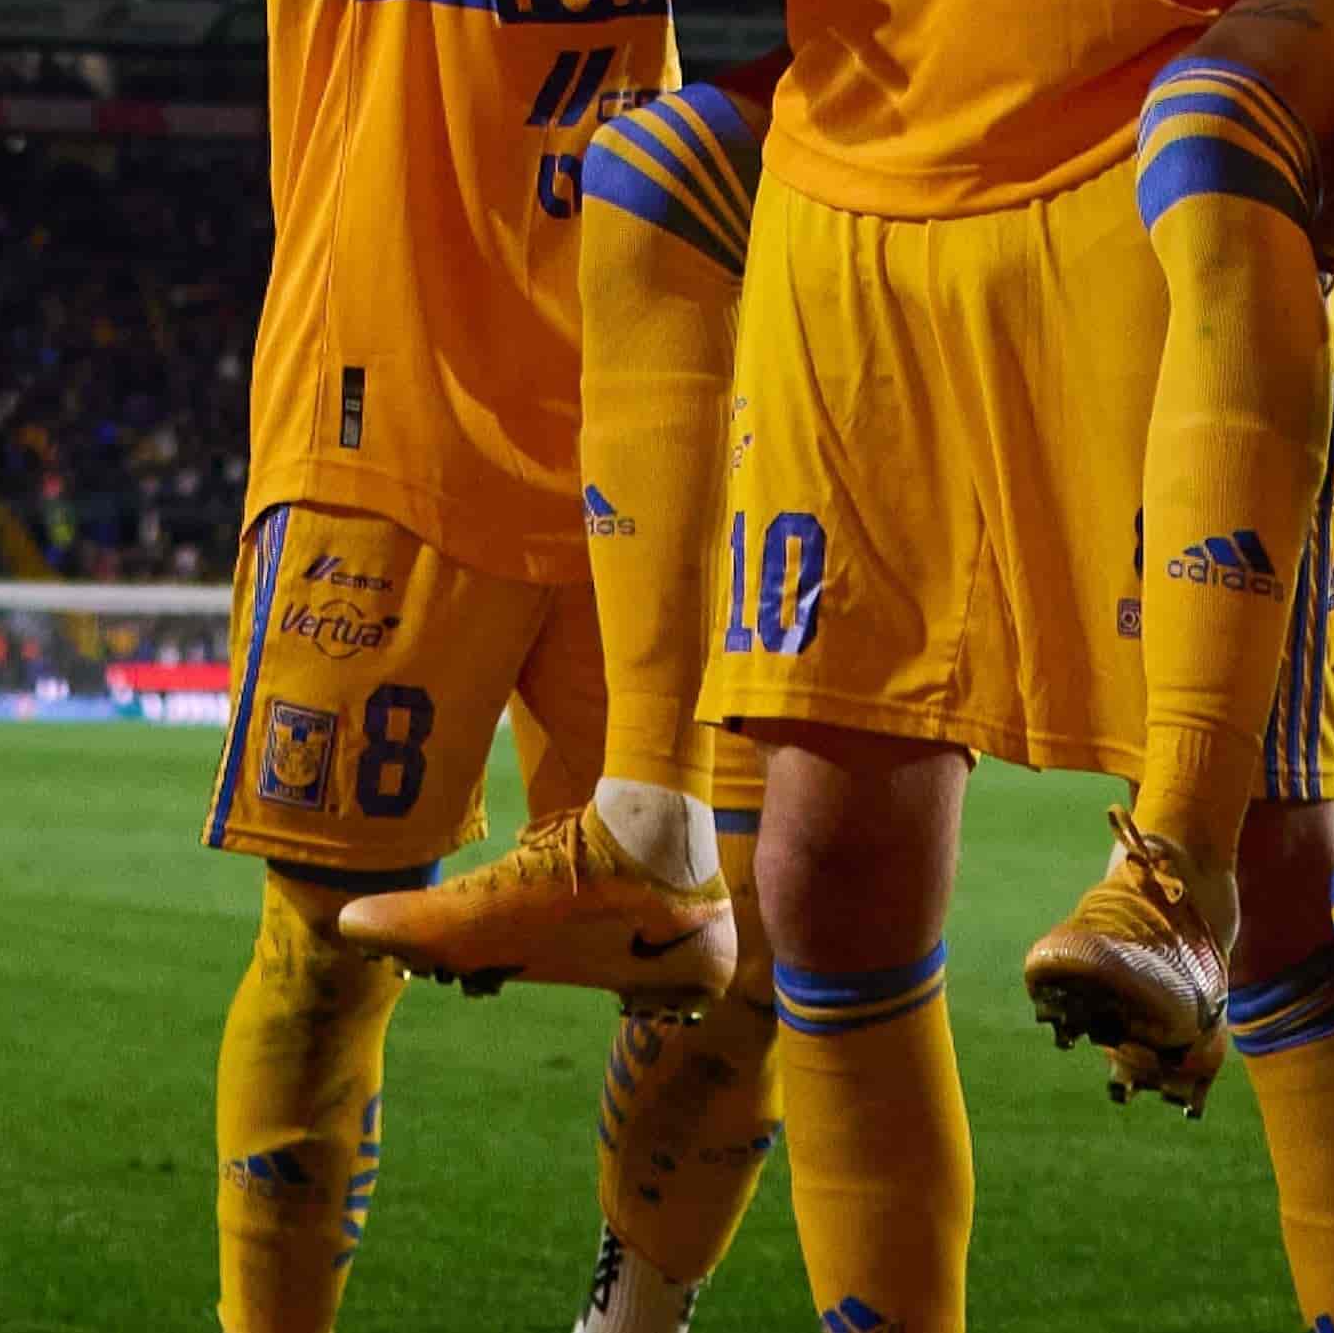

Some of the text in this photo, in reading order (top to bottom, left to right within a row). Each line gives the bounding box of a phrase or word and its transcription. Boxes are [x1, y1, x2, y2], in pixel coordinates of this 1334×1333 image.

[281, 602, 383, 647] Vertua
[725, 510, 827, 653] 10
[1168, 558, 1284, 603] adidas
[357, 682, 435, 818] 8
